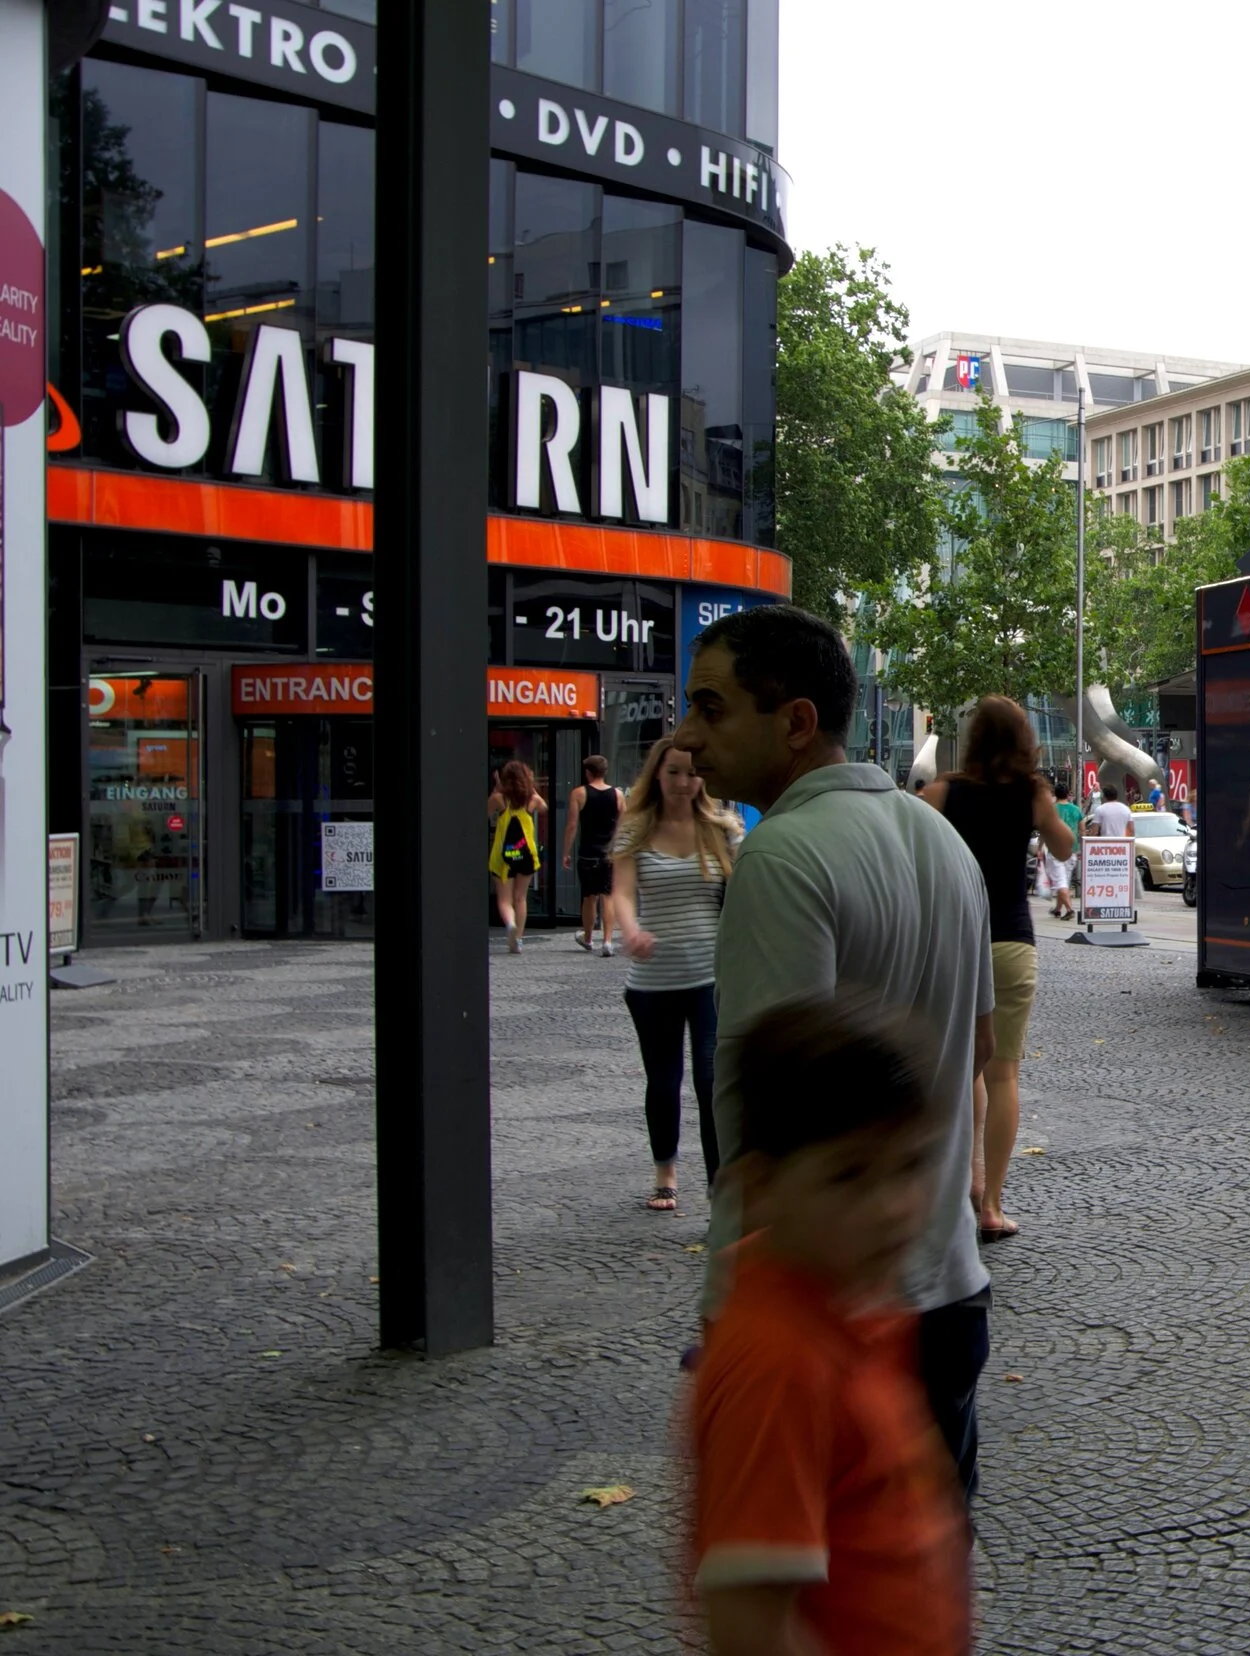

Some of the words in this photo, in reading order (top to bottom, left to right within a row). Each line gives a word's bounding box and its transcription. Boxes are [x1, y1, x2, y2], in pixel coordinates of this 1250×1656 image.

[109, 0, 357, 83] EKTRO
[538, 98, 645, 166] DVD
[701, 146, 768, 211] HIFI
[118, 303, 669, 524] SATRN
[222, 579, 286, 620] Mo
[545, 606, 580, 639] 21
[596, 609, 654, 643] Uhr
[240, 676, 374, 702] ENTRANC
[489, 679, 577, 705] INGANG
[106, 786, 188, 800] EINGANG
[346, 851, 373, 863] SATU
[1088, 859, 1128, 867] SAMSUNG
[1089, 846, 1126, 856] AKTION
[1100, 907, 1131, 918] SATURN
